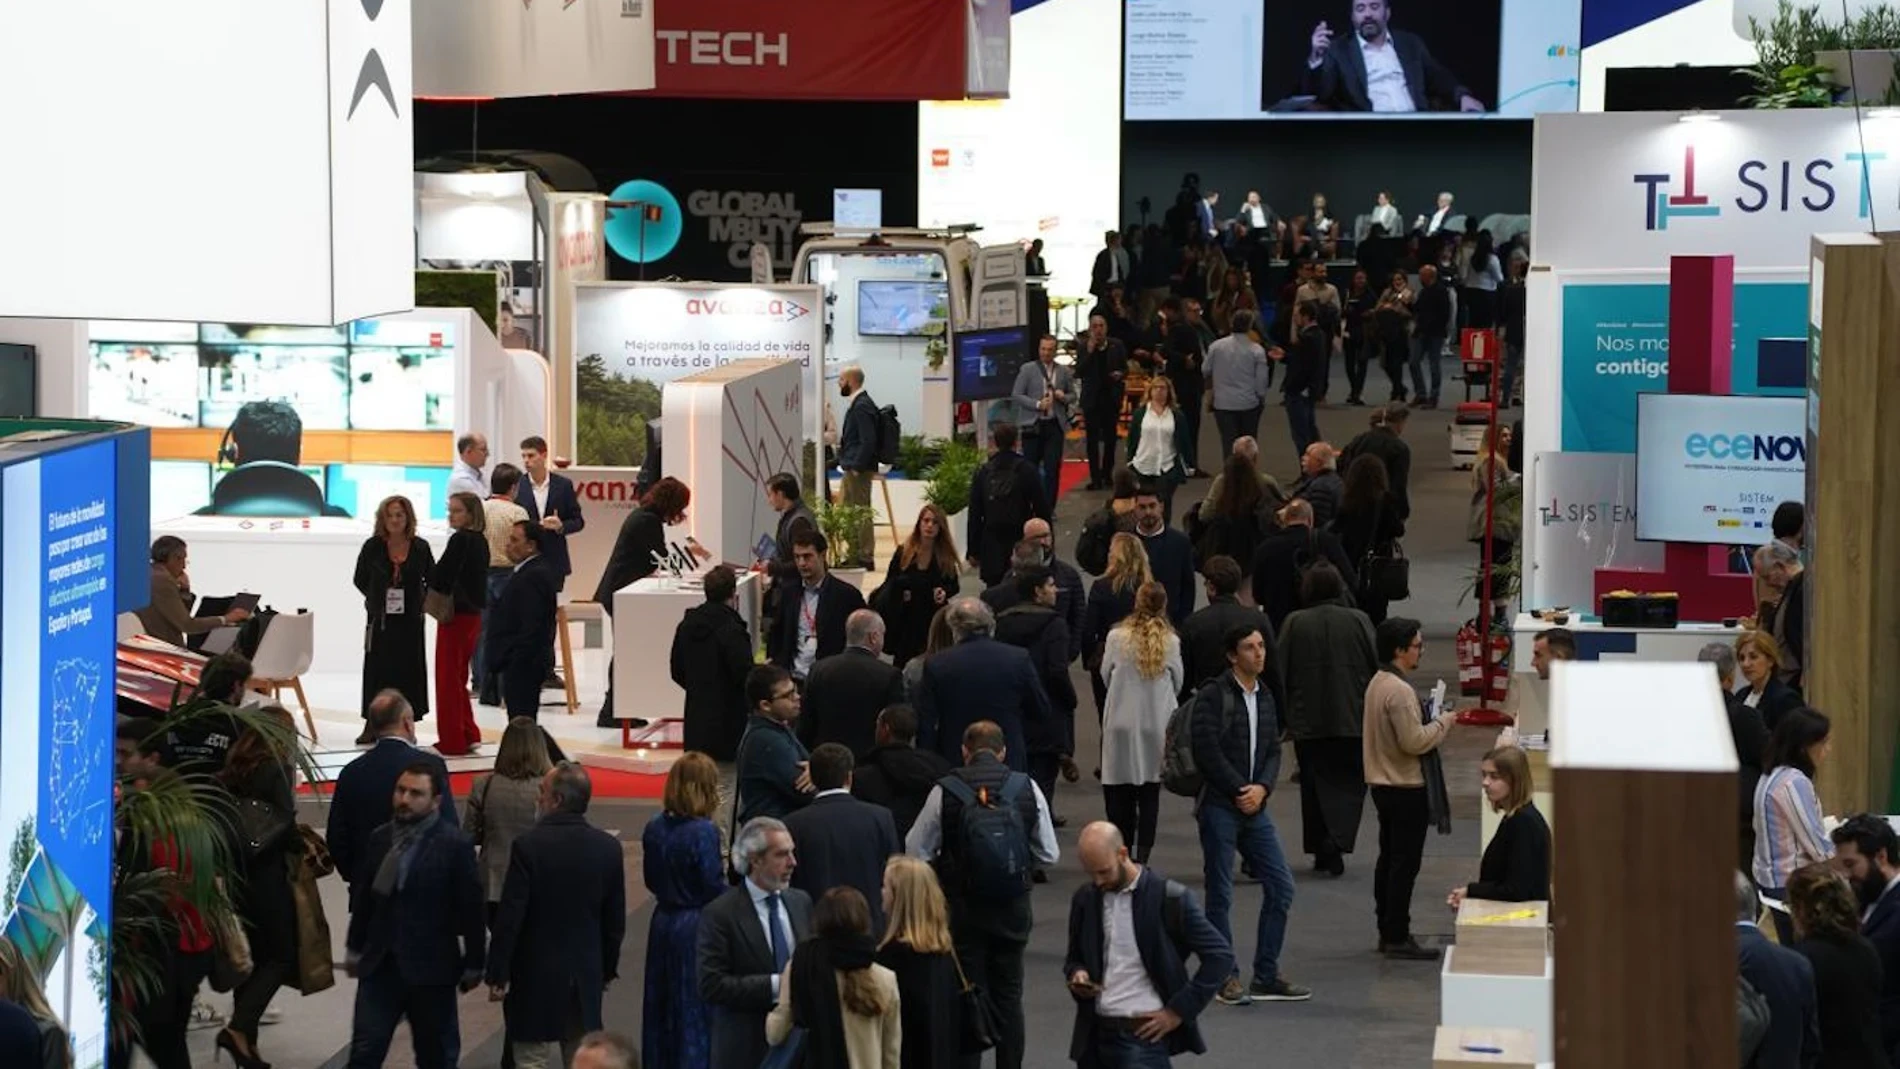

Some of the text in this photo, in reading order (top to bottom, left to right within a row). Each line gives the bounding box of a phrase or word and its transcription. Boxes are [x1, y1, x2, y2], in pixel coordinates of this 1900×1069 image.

[656, 30, 788, 66] TECH
[1735, 153, 1900, 218] SIST
[688, 190, 801, 217] GLOBAL
[709, 216, 800, 242] MBLTY
[728, 241, 794, 268] CLL
[625, 340, 810, 353] Mejoramos la calidad de vida
[1596, 333, 1635, 351] Nos
[626, 357, 636, 367] a
[640, 355, 687, 367] través
[692, 355, 711, 367] de
[1685, 433, 1805, 462] eceNOV
[576, 481, 640, 501] vanz
[1739, 493, 1775, 503] SISTEM
